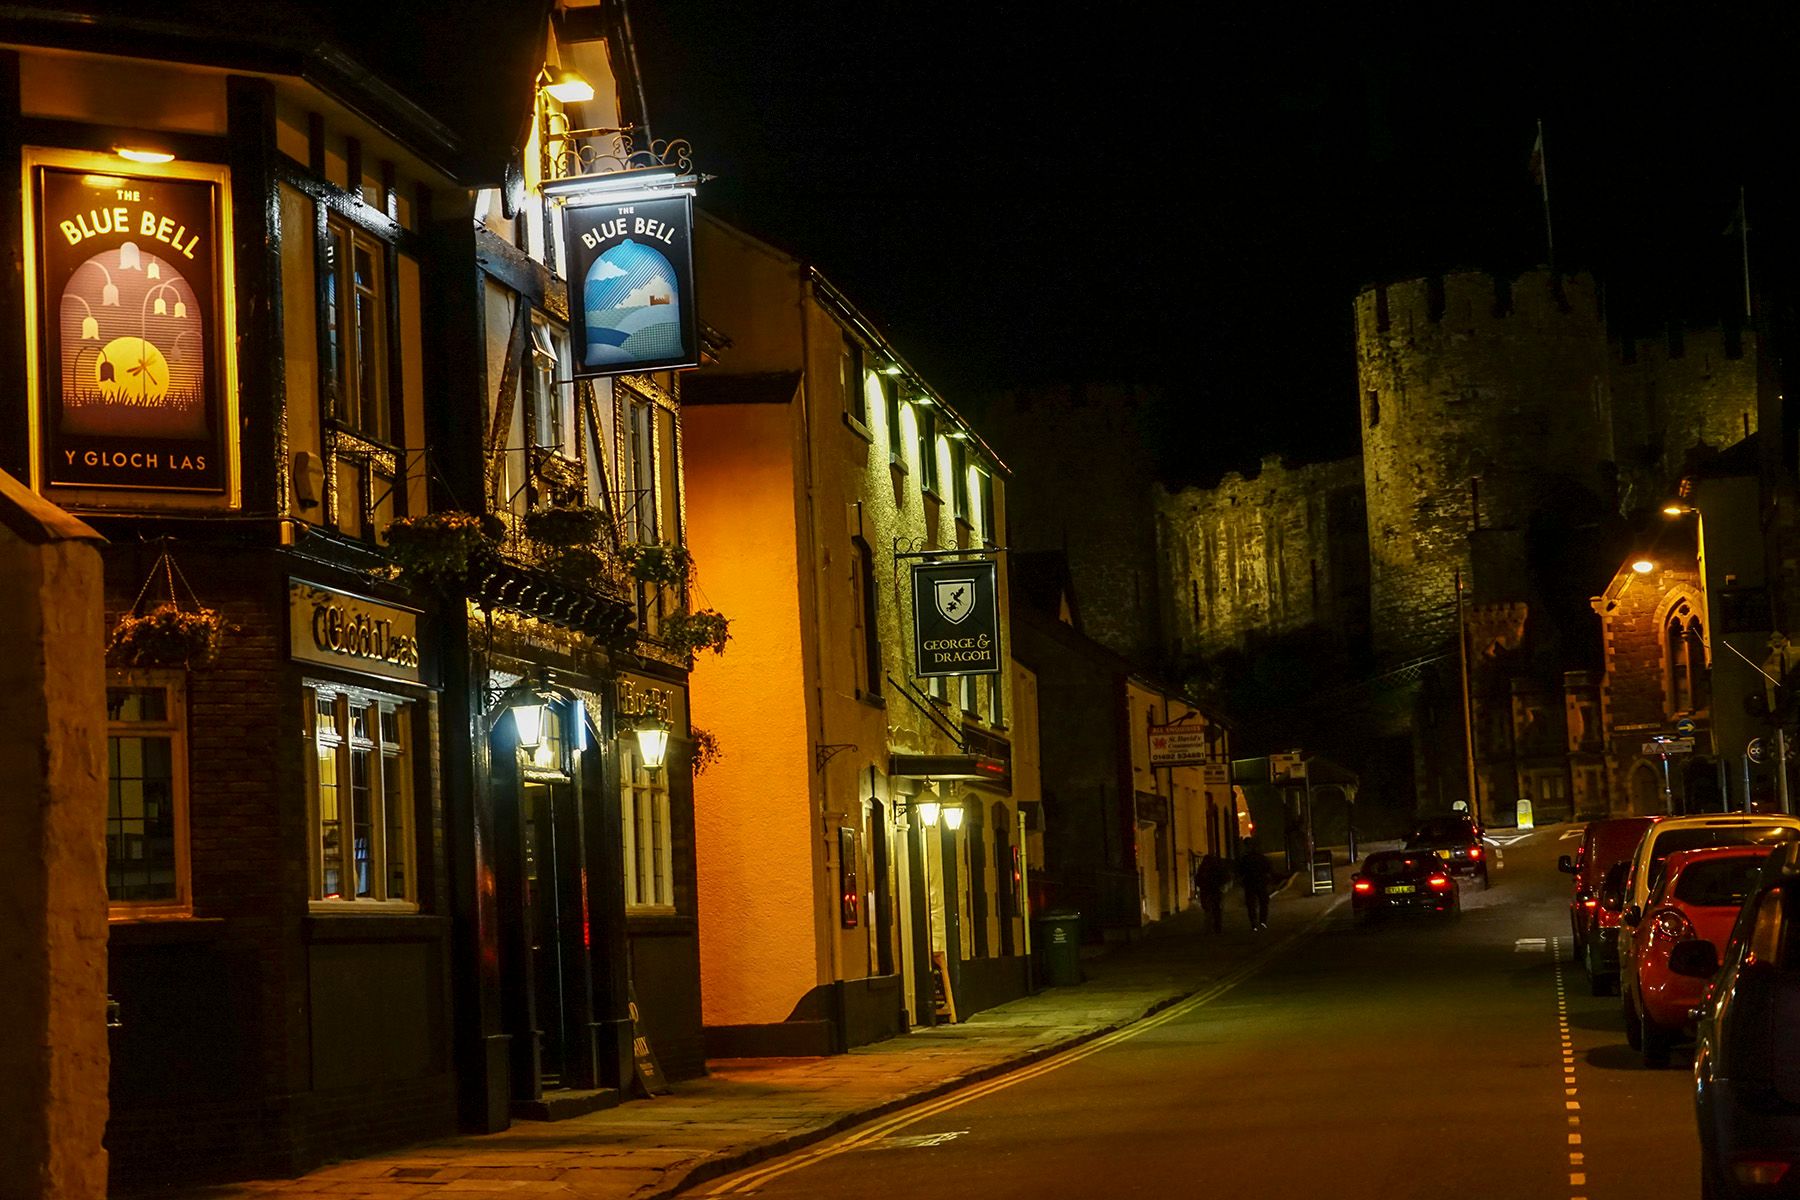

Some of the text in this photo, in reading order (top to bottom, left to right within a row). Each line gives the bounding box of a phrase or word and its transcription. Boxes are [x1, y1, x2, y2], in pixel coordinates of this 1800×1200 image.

[116, 190, 140, 202] THE
[618, 207, 635, 215] THE
[60, 207, 200, 260] BLUE BELL
[581, 217, 676, 250] BLUE BELL
[65, 450, 207, 471] Y GLOCH LAS
[325, 604, 383, 660] Gloch
[923, 633, 991, 651] GEORGE &
[934, 650, 992, 663] DRAGON
